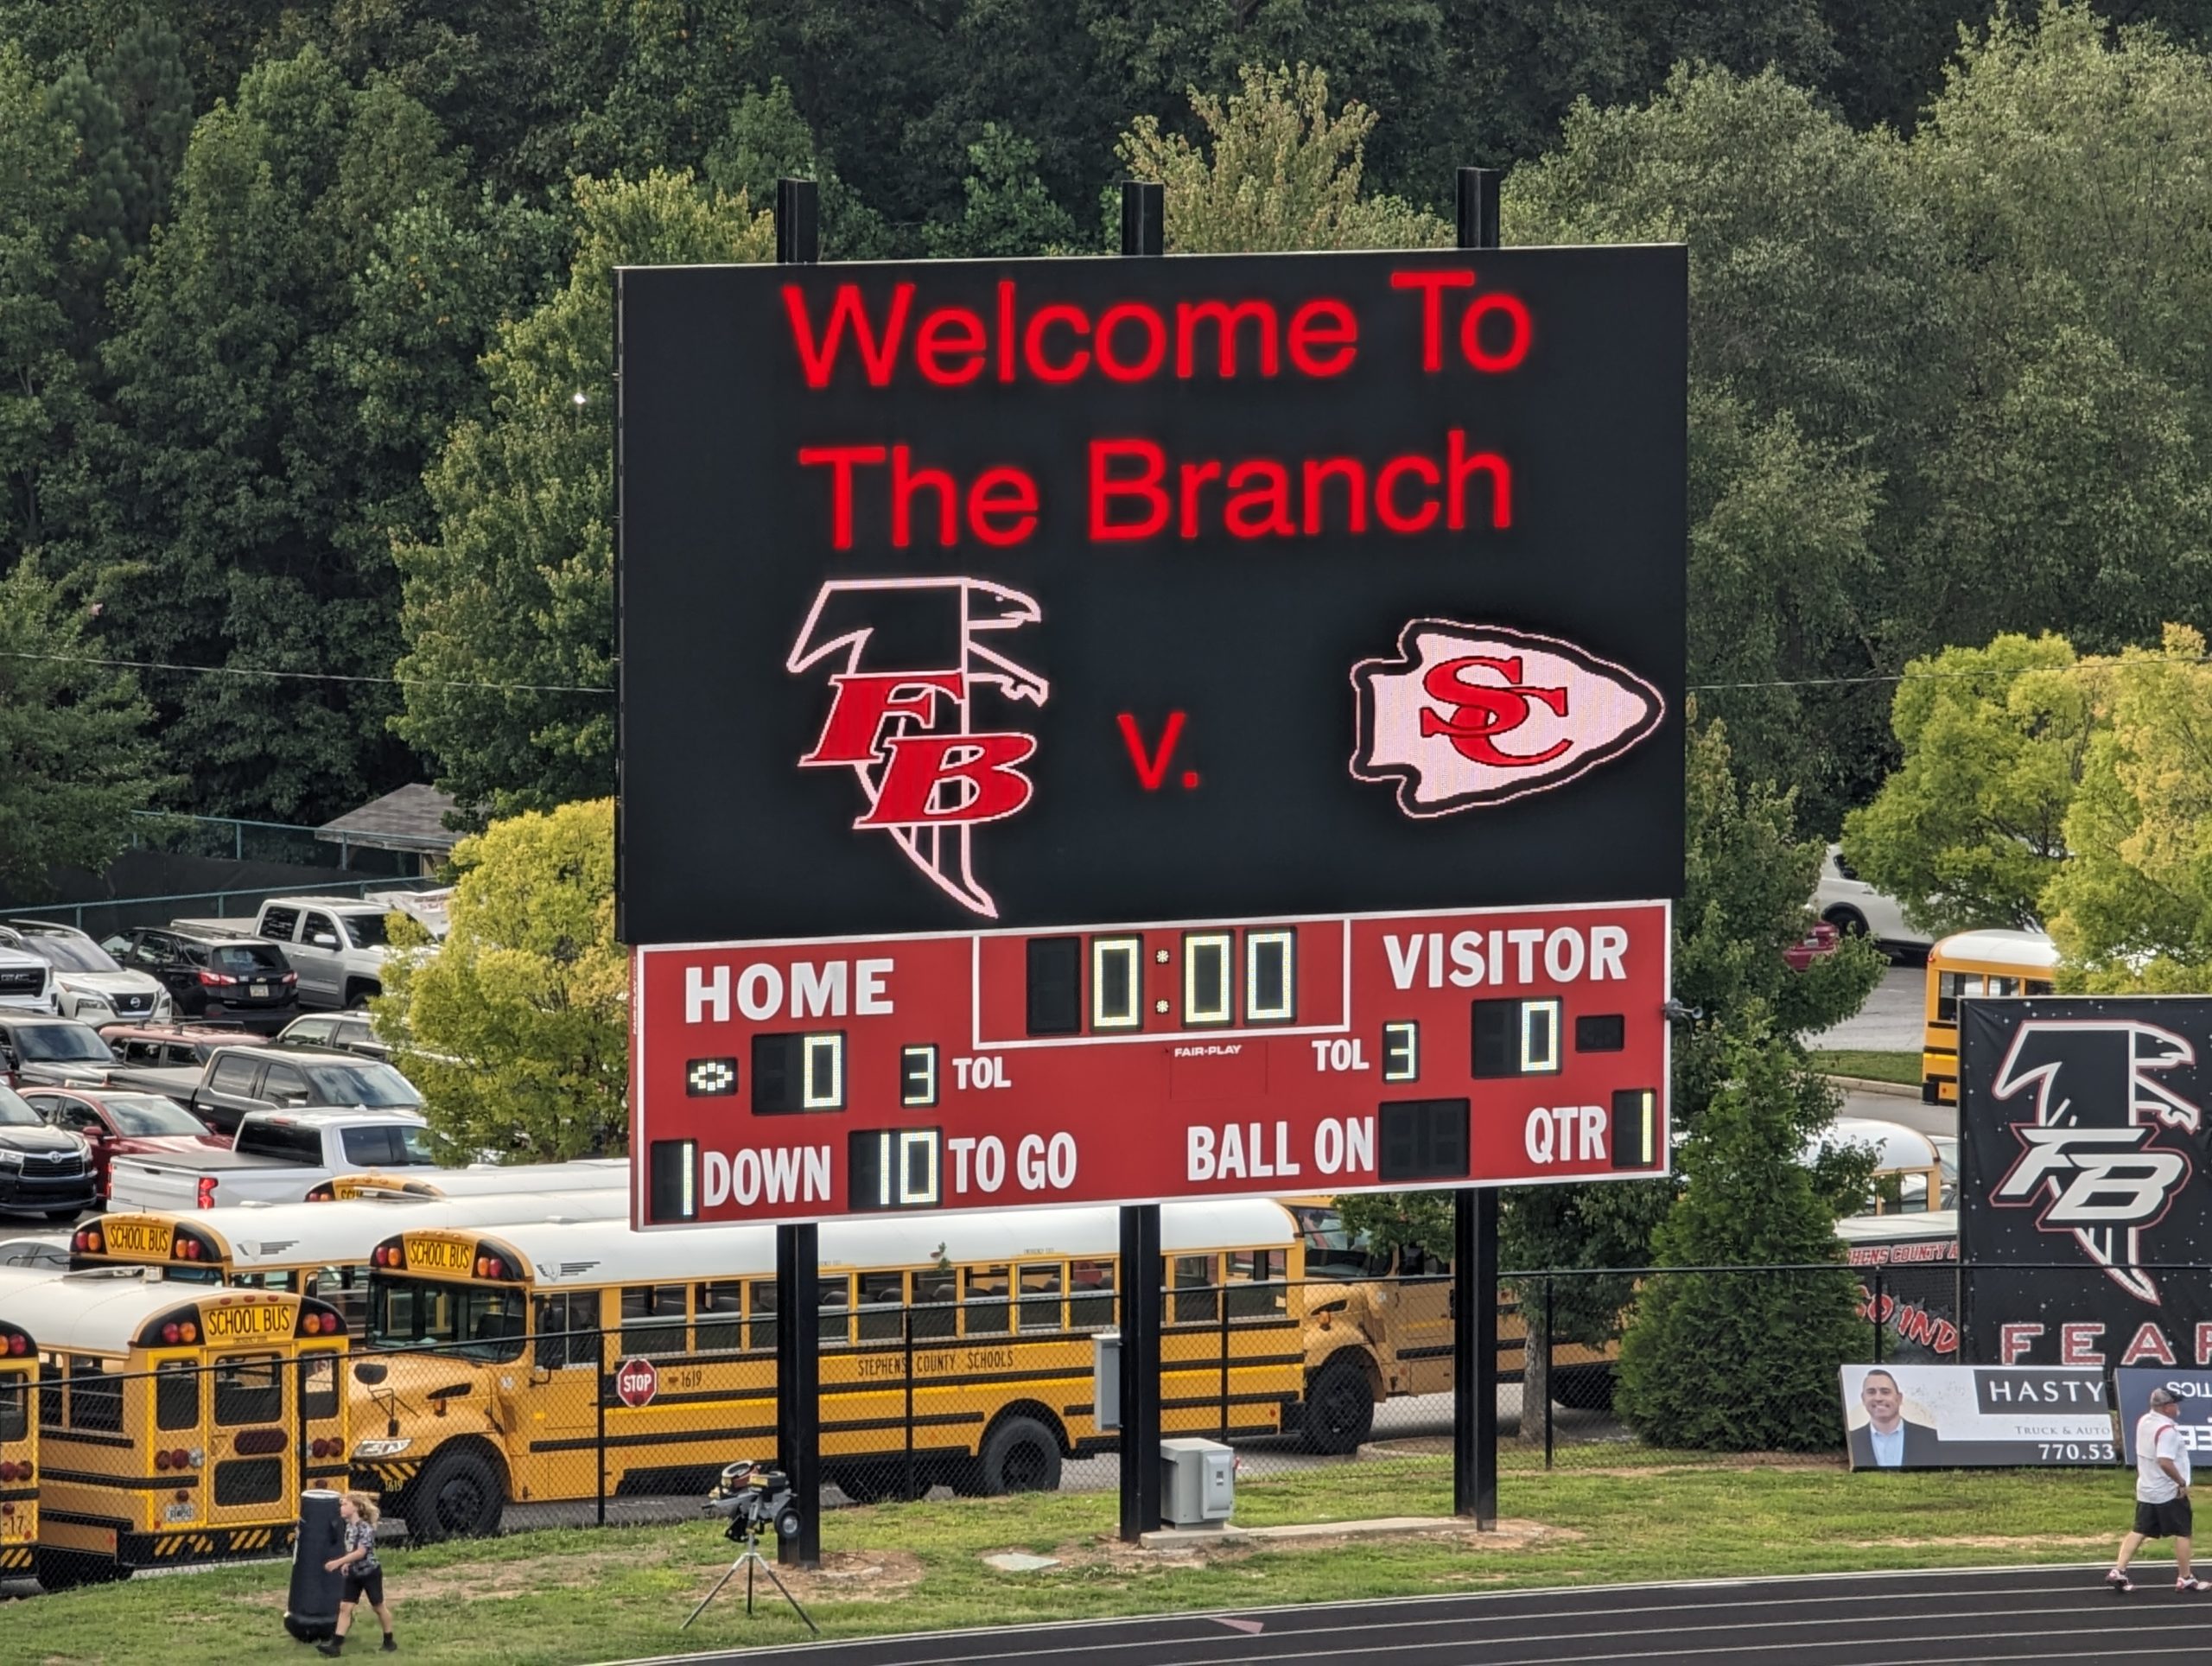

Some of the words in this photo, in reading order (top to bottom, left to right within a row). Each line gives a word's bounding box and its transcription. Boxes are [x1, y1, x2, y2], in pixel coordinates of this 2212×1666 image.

[782, 280, 1357, 388] Welcome
[1390, 270, 1531, 372] To
[798, 445, 1039, 550] The
[1089, 429, 1510, 541] Branch
[1094, 932, 1291, 1027] 0:00
[1383, 925, 1627, 989] VISITOR
[686, 958, 893, 1023] HOME
[1175, 1045, 1242, 1057] FAIR-PLAY
[1312, 1038, 1370, 1071] TOL
[1386, 1023, 1415, 1080] 3
[1521, 1001, 1558, 1071] 0
[804, 1035, 842, 1108] 0
[905, 1046, 934, 1104] 3
[953, 1056, 1011, 1090] TOL
[1187, 1121, 1300, 1181] BALL
[1314, 1116, 1374, 1173] ON
[1525, 1105, 1606, 1164] QTR
[1642, 1091, 1652, 1163] 1
[683, 1142, 693, 1215] 1
[702, 1145, 831, 1207] DOWN
[880, 1131, 937, 1205] 10
[948, 1135, 1005, 1192] TO
[1016, 1131, 1077, 1191] GO
[110, 1225, 145, 1250] SCHOOL
[149, 1229, 168, 1251] BUS
[410, 1240, 446, 1266] SCHOOL
[449, 1245, 469, 1269] BUS
[1891, 1240, 1949, 1263] COUNTY
[208, 1308, 260, 1336] SCHOOL
[264, 1307, 290, 1332] BUS
[623, 1373, 652, 1393] STOP
[681, 1370, 702, 1388] 1619
[858, 1356, 906, 1377] STEPHENS
[917, 1354, 957, 1373] COUNTY
[967, 1351, 1014, 1370] SCHOOLS
[1989, 1381, 2104, 1402] HASTY
[2038, 1443, 2115, 1460] 770.53
[2062, 1426, 2071, 1435] &
